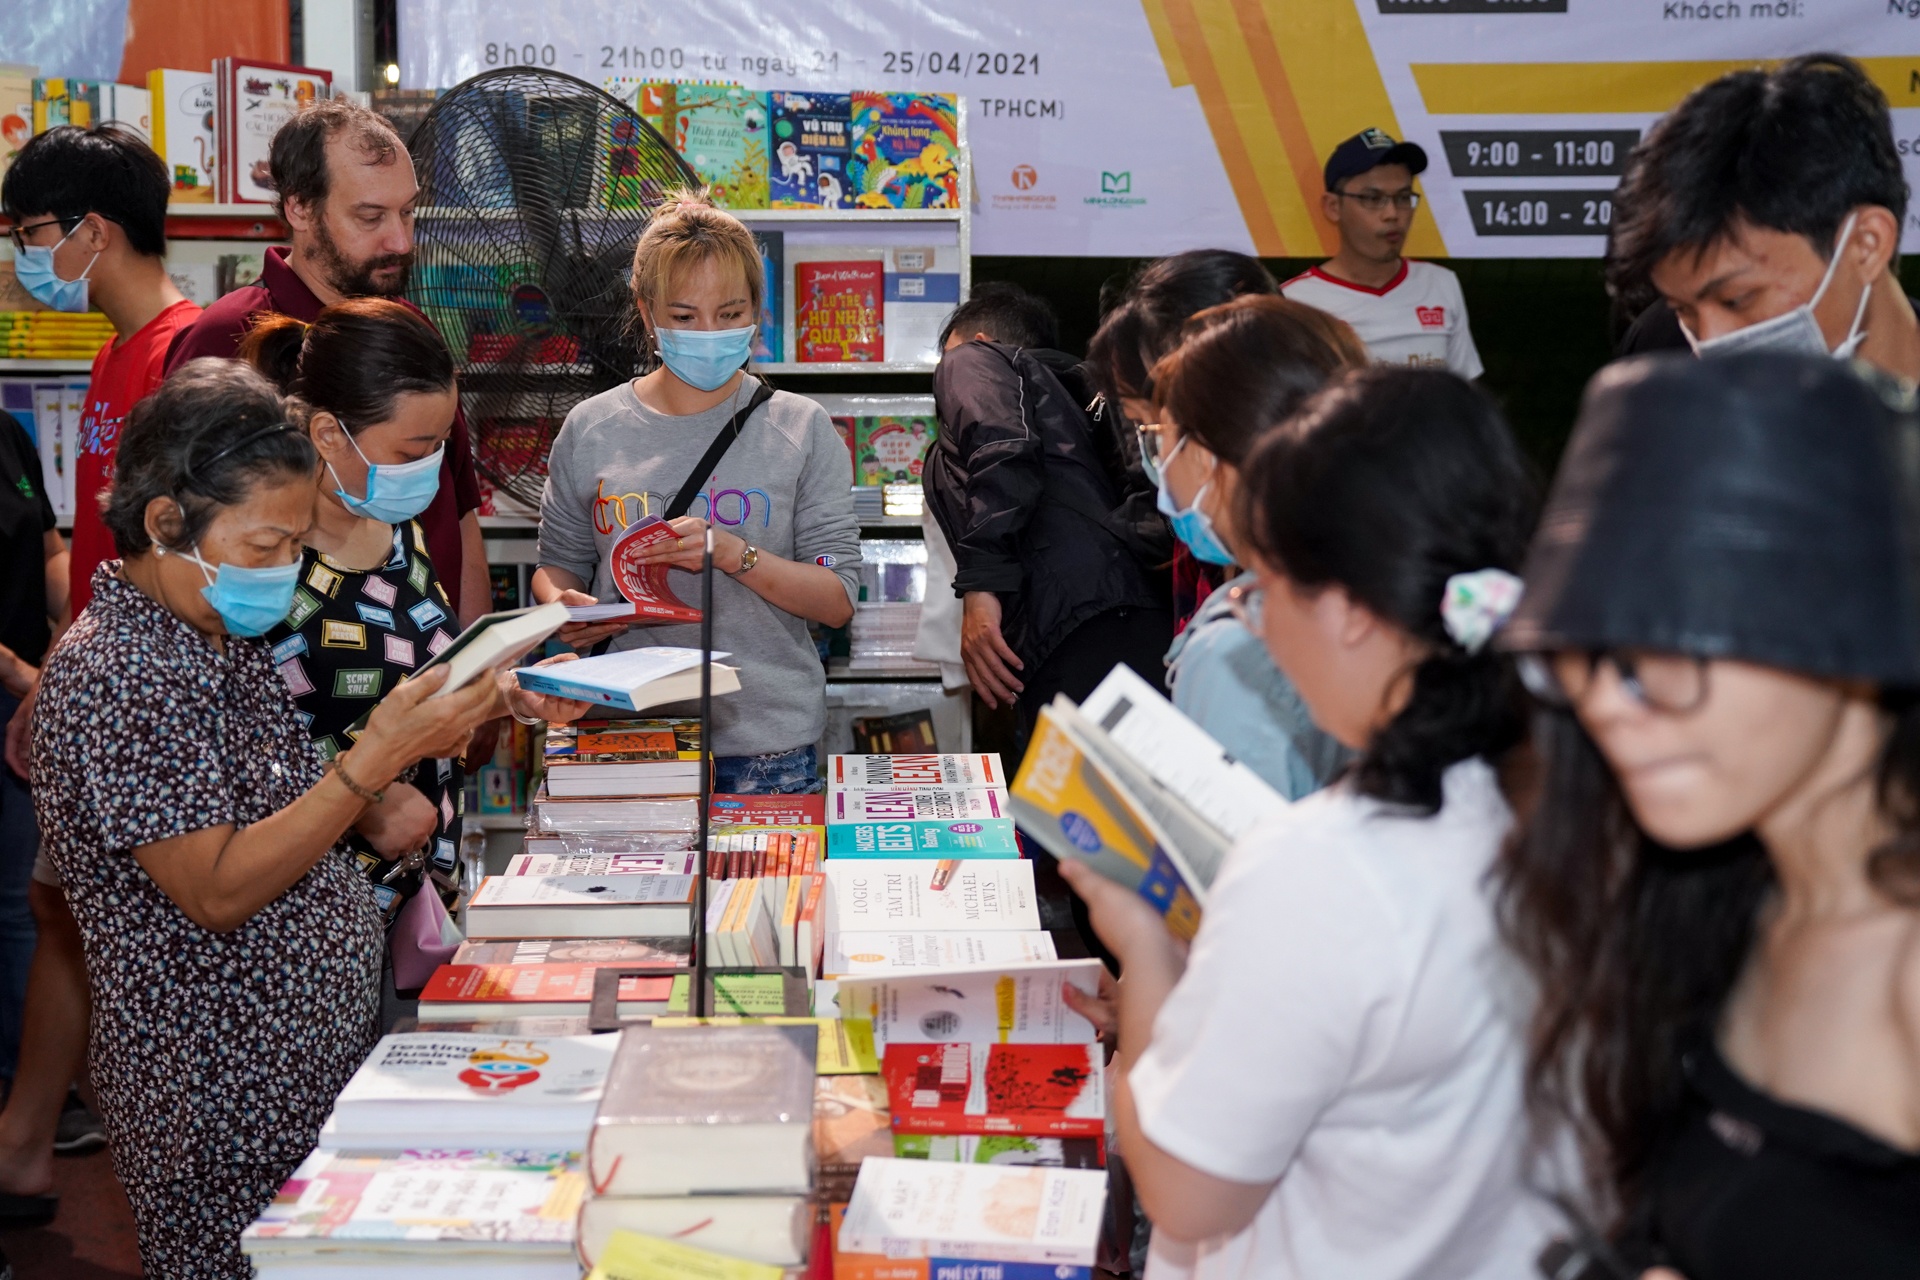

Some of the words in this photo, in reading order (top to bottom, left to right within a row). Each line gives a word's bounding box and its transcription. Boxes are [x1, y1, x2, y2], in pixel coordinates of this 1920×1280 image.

[1663, 0, 1741, 20] Khách
[485, 42, 556, 67] 8h00
[601, 46, 684, 69] 21h00
[812, 50, 838, 72] 21
[883, 51, 1041, 78] 25/04/2021
[979, 98, 1065, 120] TPHCM)
[1467, 141, 1520, 167] 9:00
[1554, 140, 1615, 166] 11:00
[1482, 201, 1549, 226] 14:00
[593, 475, 771, 535] chamion
[330, 631, 359, 641] PERSON
[345, 673, 375, 684] SCARY
[347, 684, 370, 694] SALE
[865, 755, 893, 785] RUNNING
[891, 755, 943, 784] LEAN
[864, 792, 915, 819] LEAN
[915, 794, 934, 816] CUSTOMER
[933, 791, 955, 819] DEVELOPMENT
[711, 815, 812, 826] IELTS
[855, 825, 876, 852] HACKERS
[876, 824, 914, 851] IELTS
[919, 827, 941, 849] Reading
[591, 856, 611, 875] CUSTOME
[608, 853, 666, 874] LEA
[853, 878, 868, 914] LOGIC
[883, 873, 902, 895] TRÍ
[962, 872, 980, 920] MICHAEL
[886, 896, 903, 919] TÂM
[981, 881, 998, 913] LEWIS
[511, 970, 545, 996] CHINA
[387, 1051, 494, 1060] Business
[389, 1043, 478, 1053] Testing
